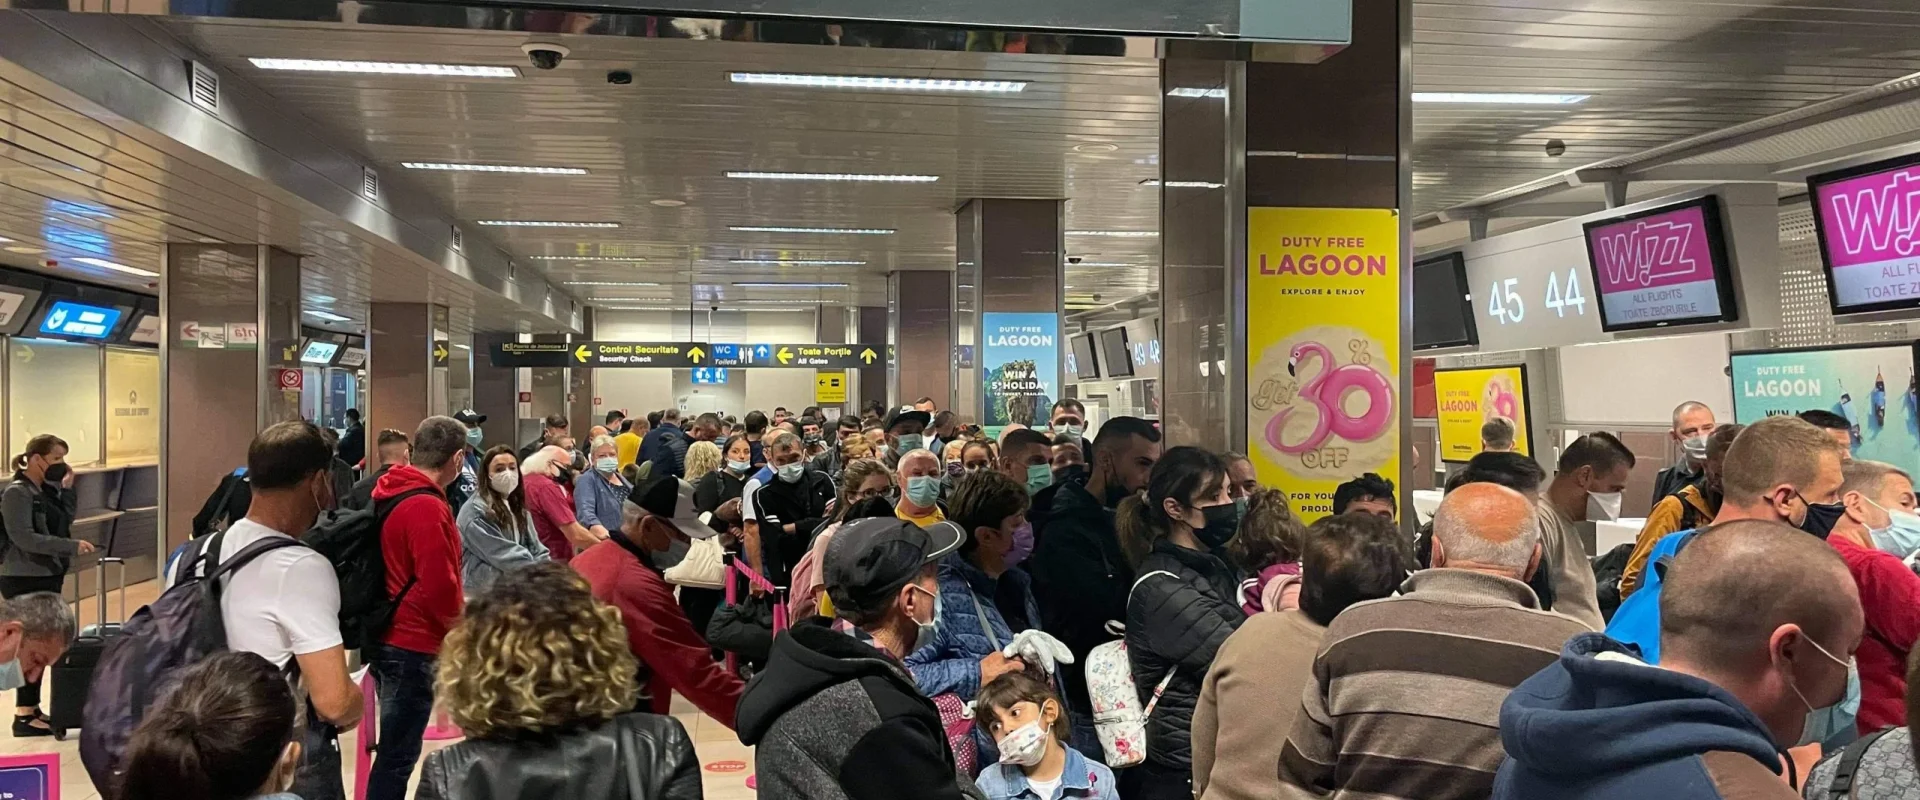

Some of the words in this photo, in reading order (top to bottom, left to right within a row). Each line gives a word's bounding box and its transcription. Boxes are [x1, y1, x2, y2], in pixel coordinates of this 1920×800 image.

[1282, 237, 1321, 248] DUTY
[1327, 237, 1364, 248] FREE
[1259, 254, 1386, 276] LAGOON
[1882, 265, 1905, 279] ALL
[1545, 267, 1585, 318] 44
[1633, 292, 1645, 304] ALL
[1648, 288, 1683, 302] FLIGHTS
[1865, 285, 1908, 299] TOATE
[1489, 277, 1524, 325] 45
[1623, 308, 1649, 320] TOATE
[1650, 302, 1698, 317] ZBORURILE
[988, 335, 1052, 346] LAGOON
[1135, 343, 1146, 365] 49
[1757, 366, 1779, 375] DUTY
[1782, 365, 1804, 374] FREE
[1745, 378, 1821, 397] LAGOON
[1440, 400, 1477, 411] LAGOON
[1301, 448, 1348, 467] OFF
